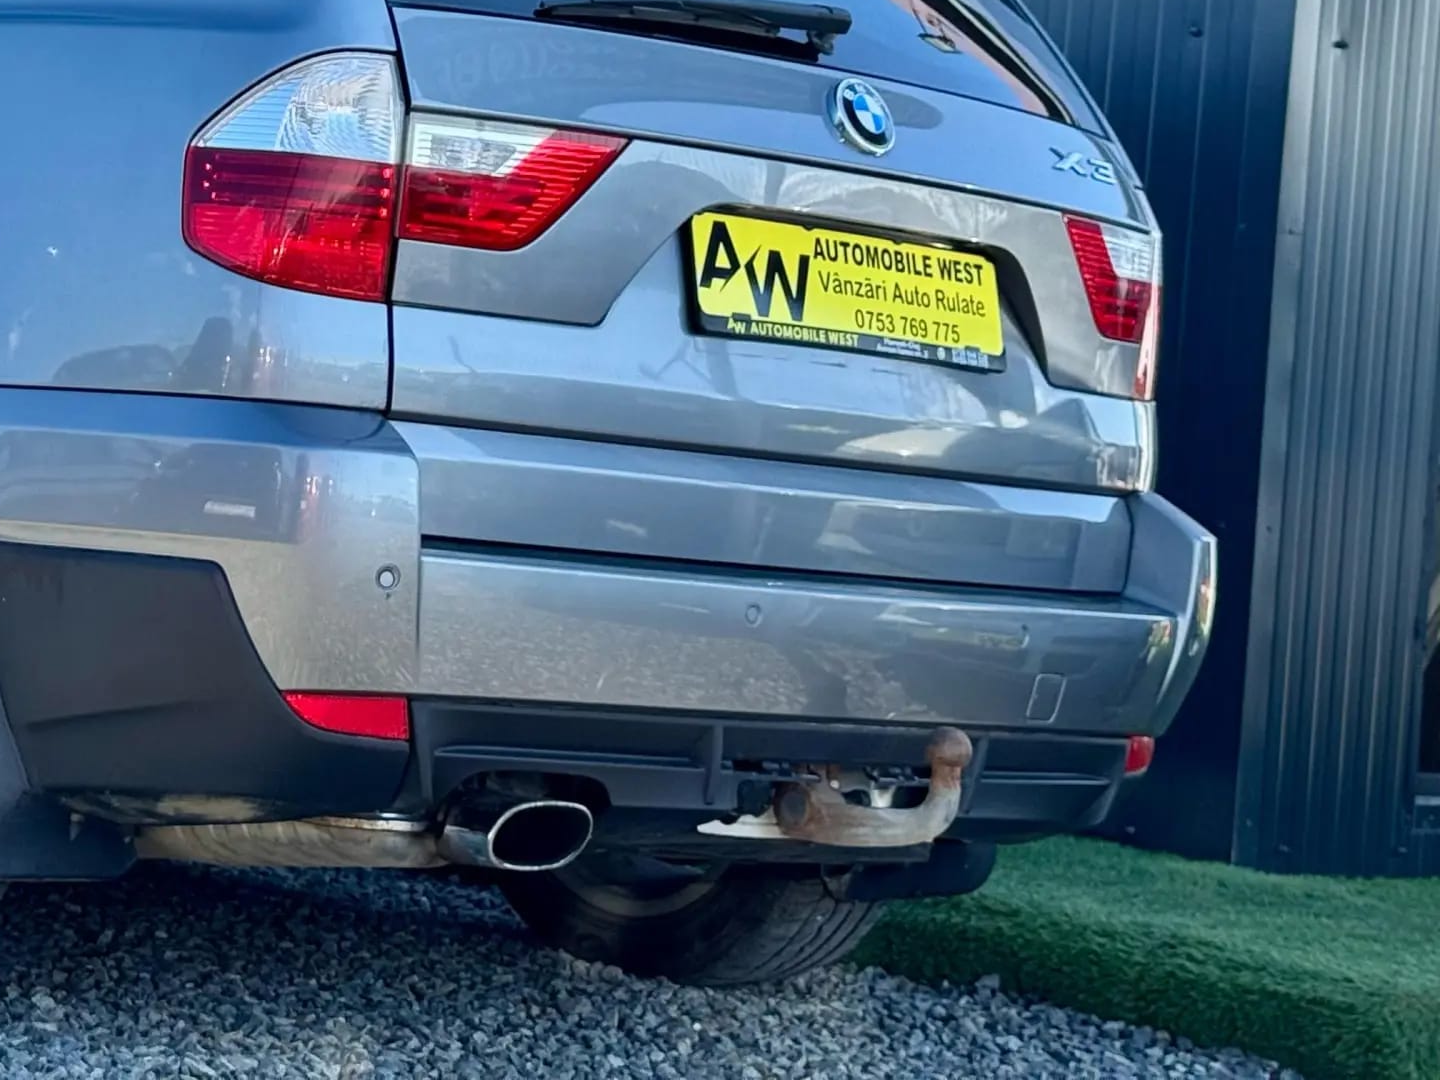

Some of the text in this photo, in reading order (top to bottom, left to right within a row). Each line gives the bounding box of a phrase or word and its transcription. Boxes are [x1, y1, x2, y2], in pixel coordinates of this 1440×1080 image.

[1048, 147, 1117, 185] X3
[813, 237, 983, 287] AUTOMOBILE WEST
[893, 282, 931, 308] Auto
[935, 289, 986, 317] Rulate
[750, 322, 827, 344] AUTOMOBILE
[828, 331, 859, 348] WEST
[855, 309, 960, 344] 0753 769 775
